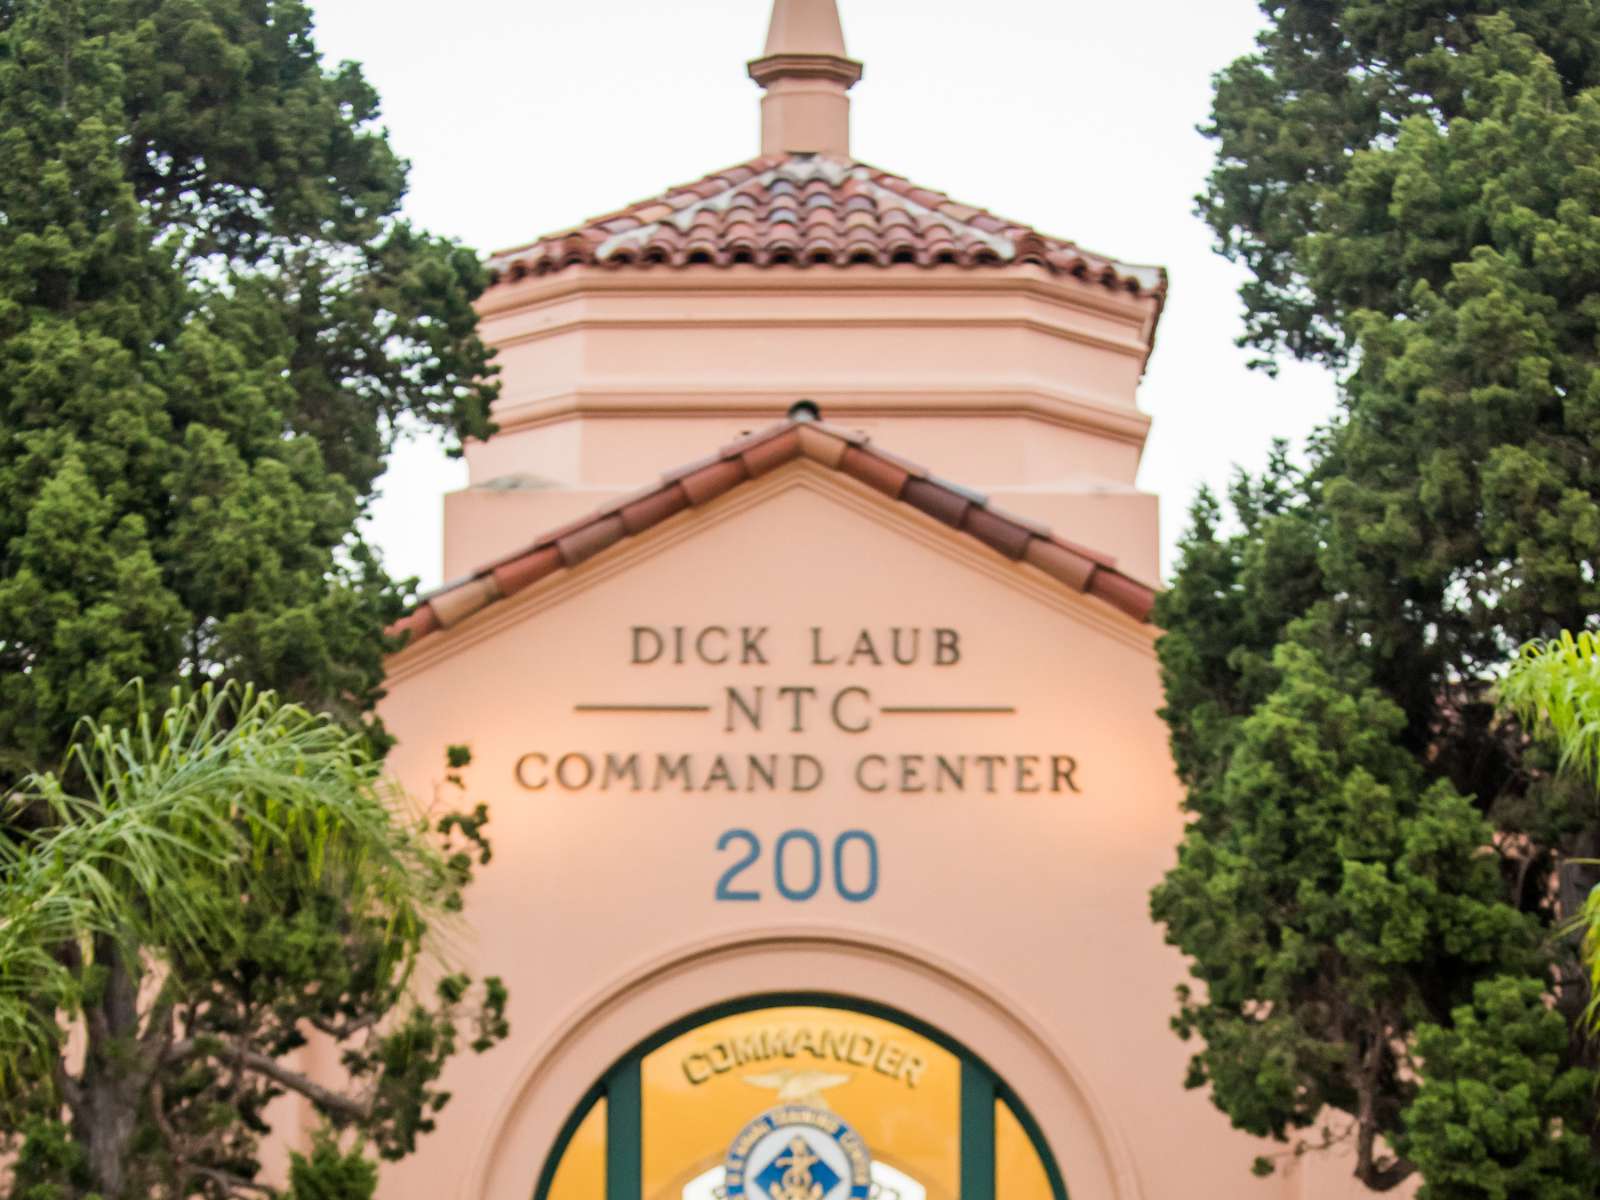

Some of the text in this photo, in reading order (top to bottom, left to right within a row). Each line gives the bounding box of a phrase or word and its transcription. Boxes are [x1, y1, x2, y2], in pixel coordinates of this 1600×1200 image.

[630, 625, 963, 668] DICK LAUB
[723, 685, 873, 735] NTC
[513, 752, 1082, 795] COMMAND CENTER
[714, 827, 881, 904] 200
[682, 1028, 927, 1088] COMMANDER
